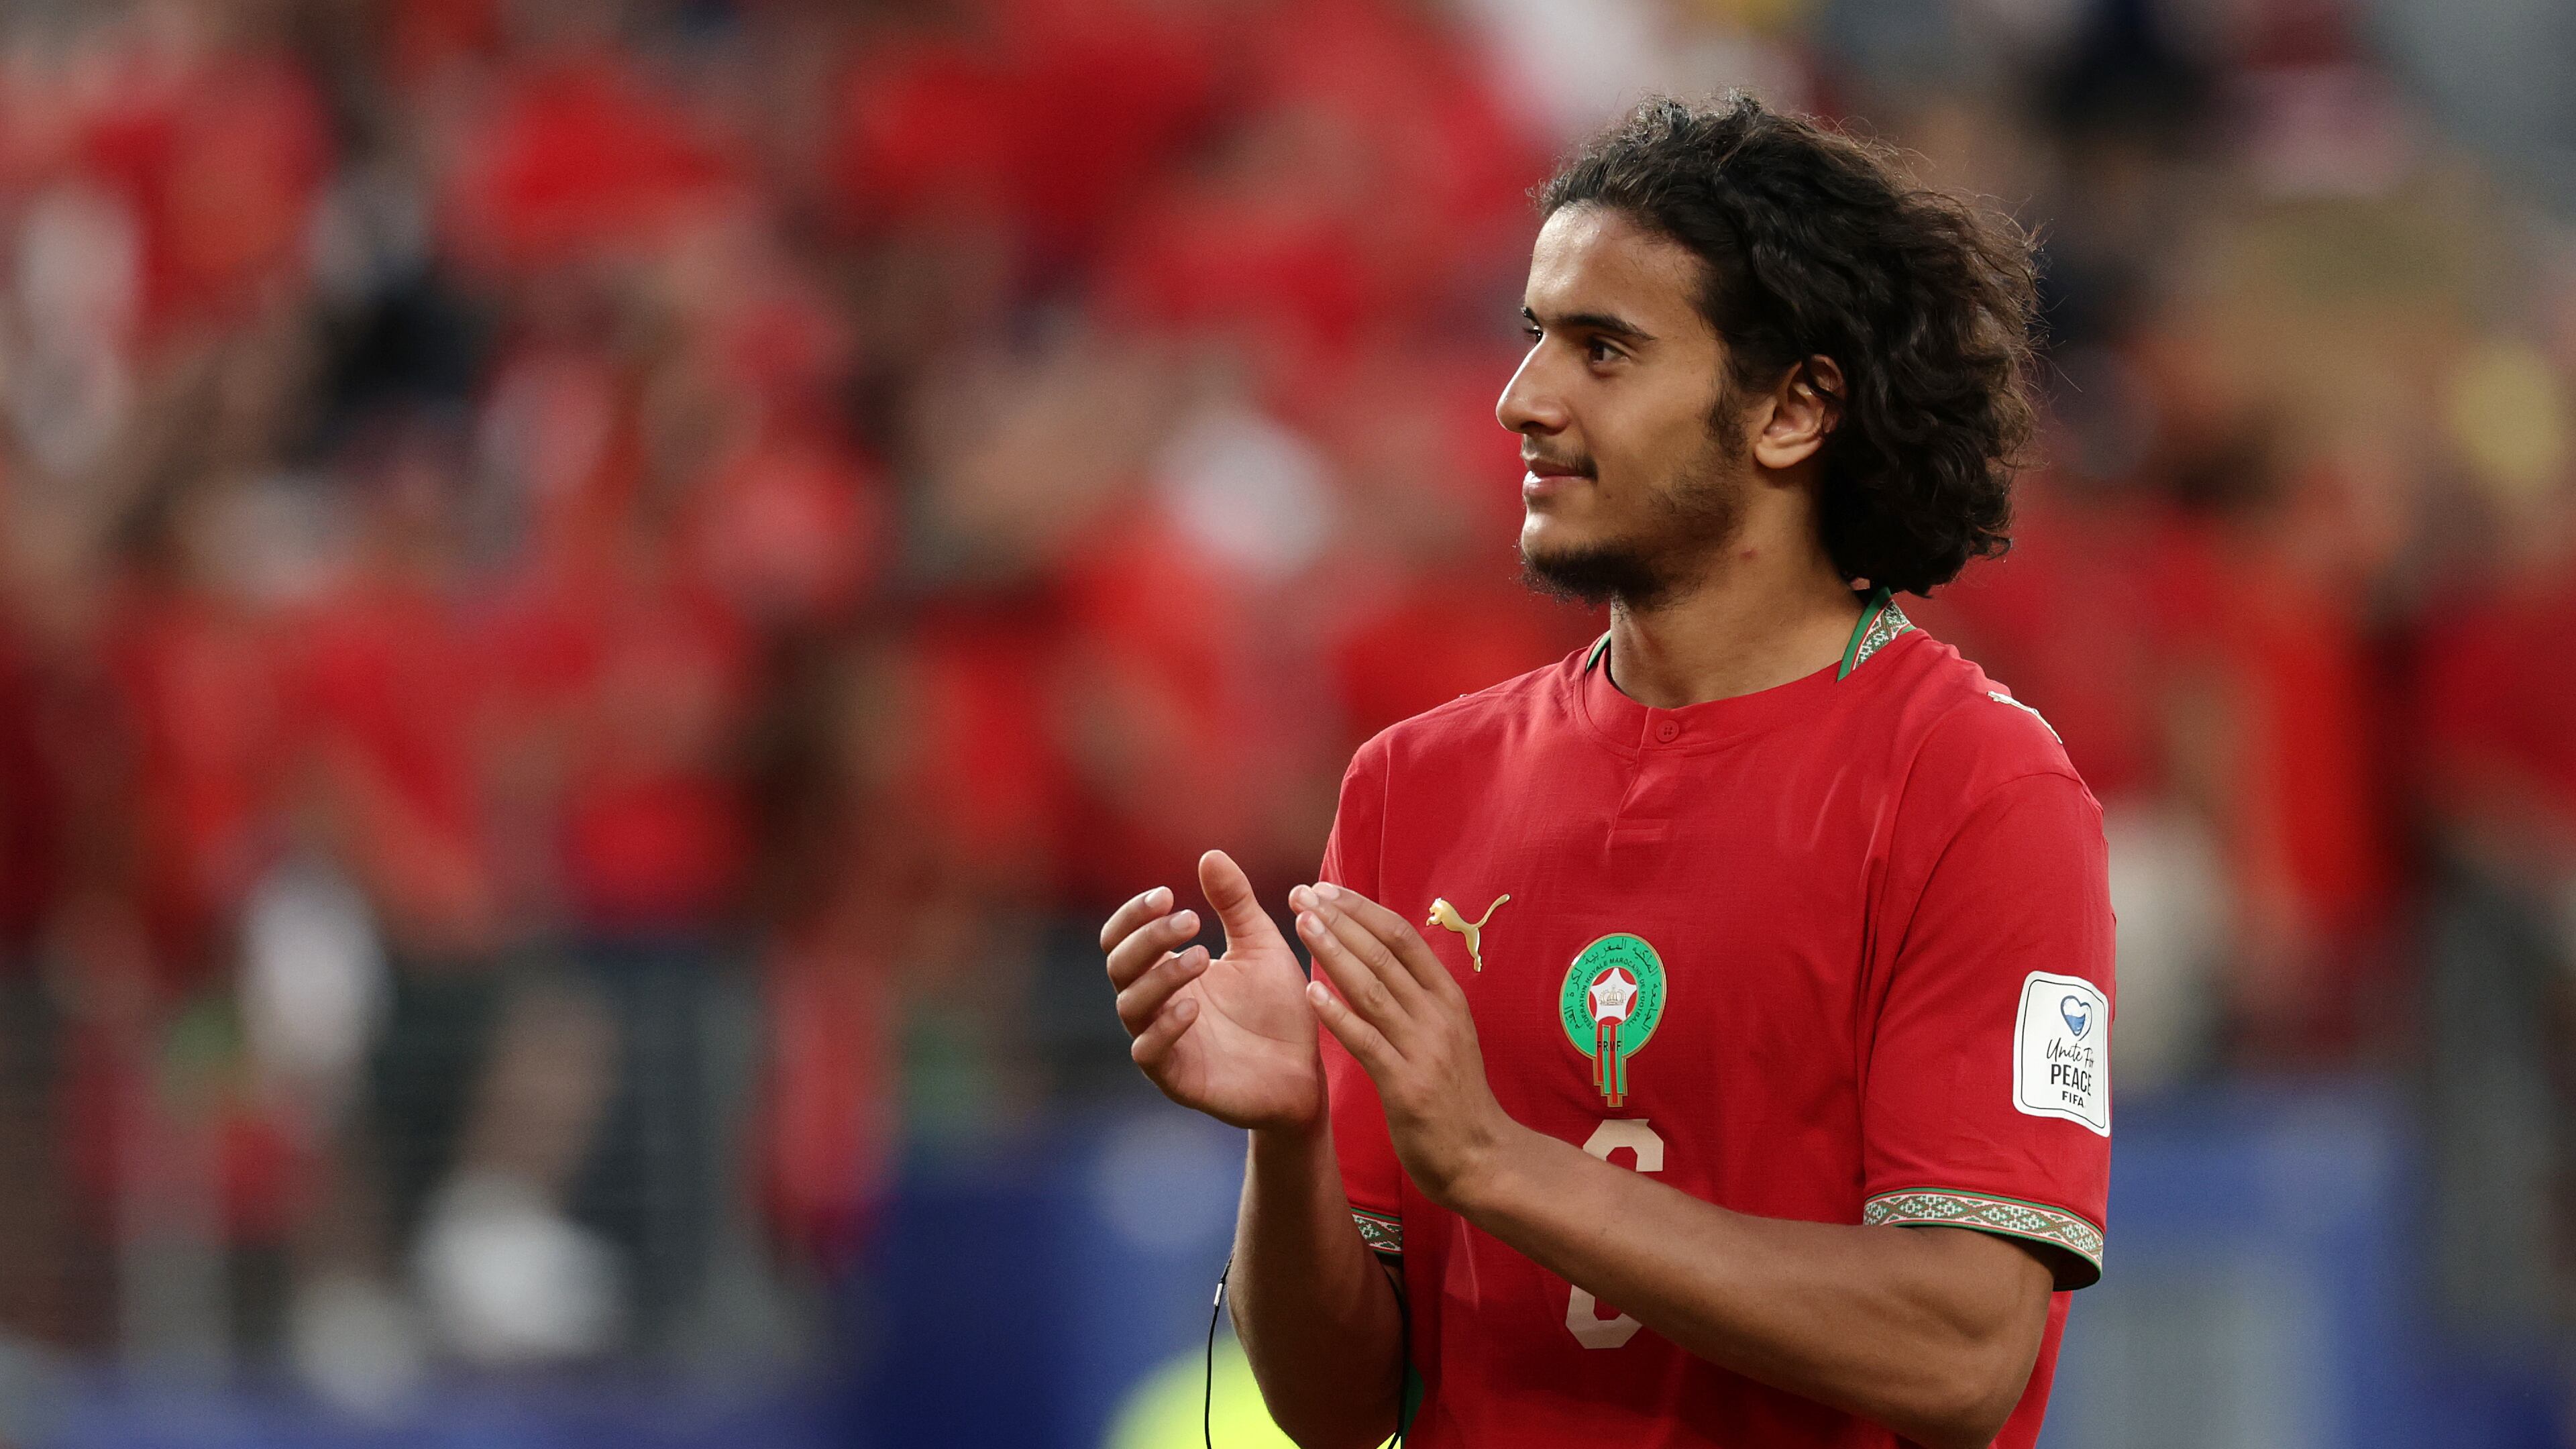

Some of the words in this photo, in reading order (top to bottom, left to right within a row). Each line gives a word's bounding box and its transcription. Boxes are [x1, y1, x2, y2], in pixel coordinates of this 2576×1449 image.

[1579, 985, 1594, 1030] FEDERATION
[1640, 979, 1646, 988] DE
[1597, 1040, 1621, 1052] FRMF
[2047, 1037, 2083, 1062] Unite
[2051, 1064, 2092, 1096] PEACE
[2062, 1090, 2084, 1108] FIFA
